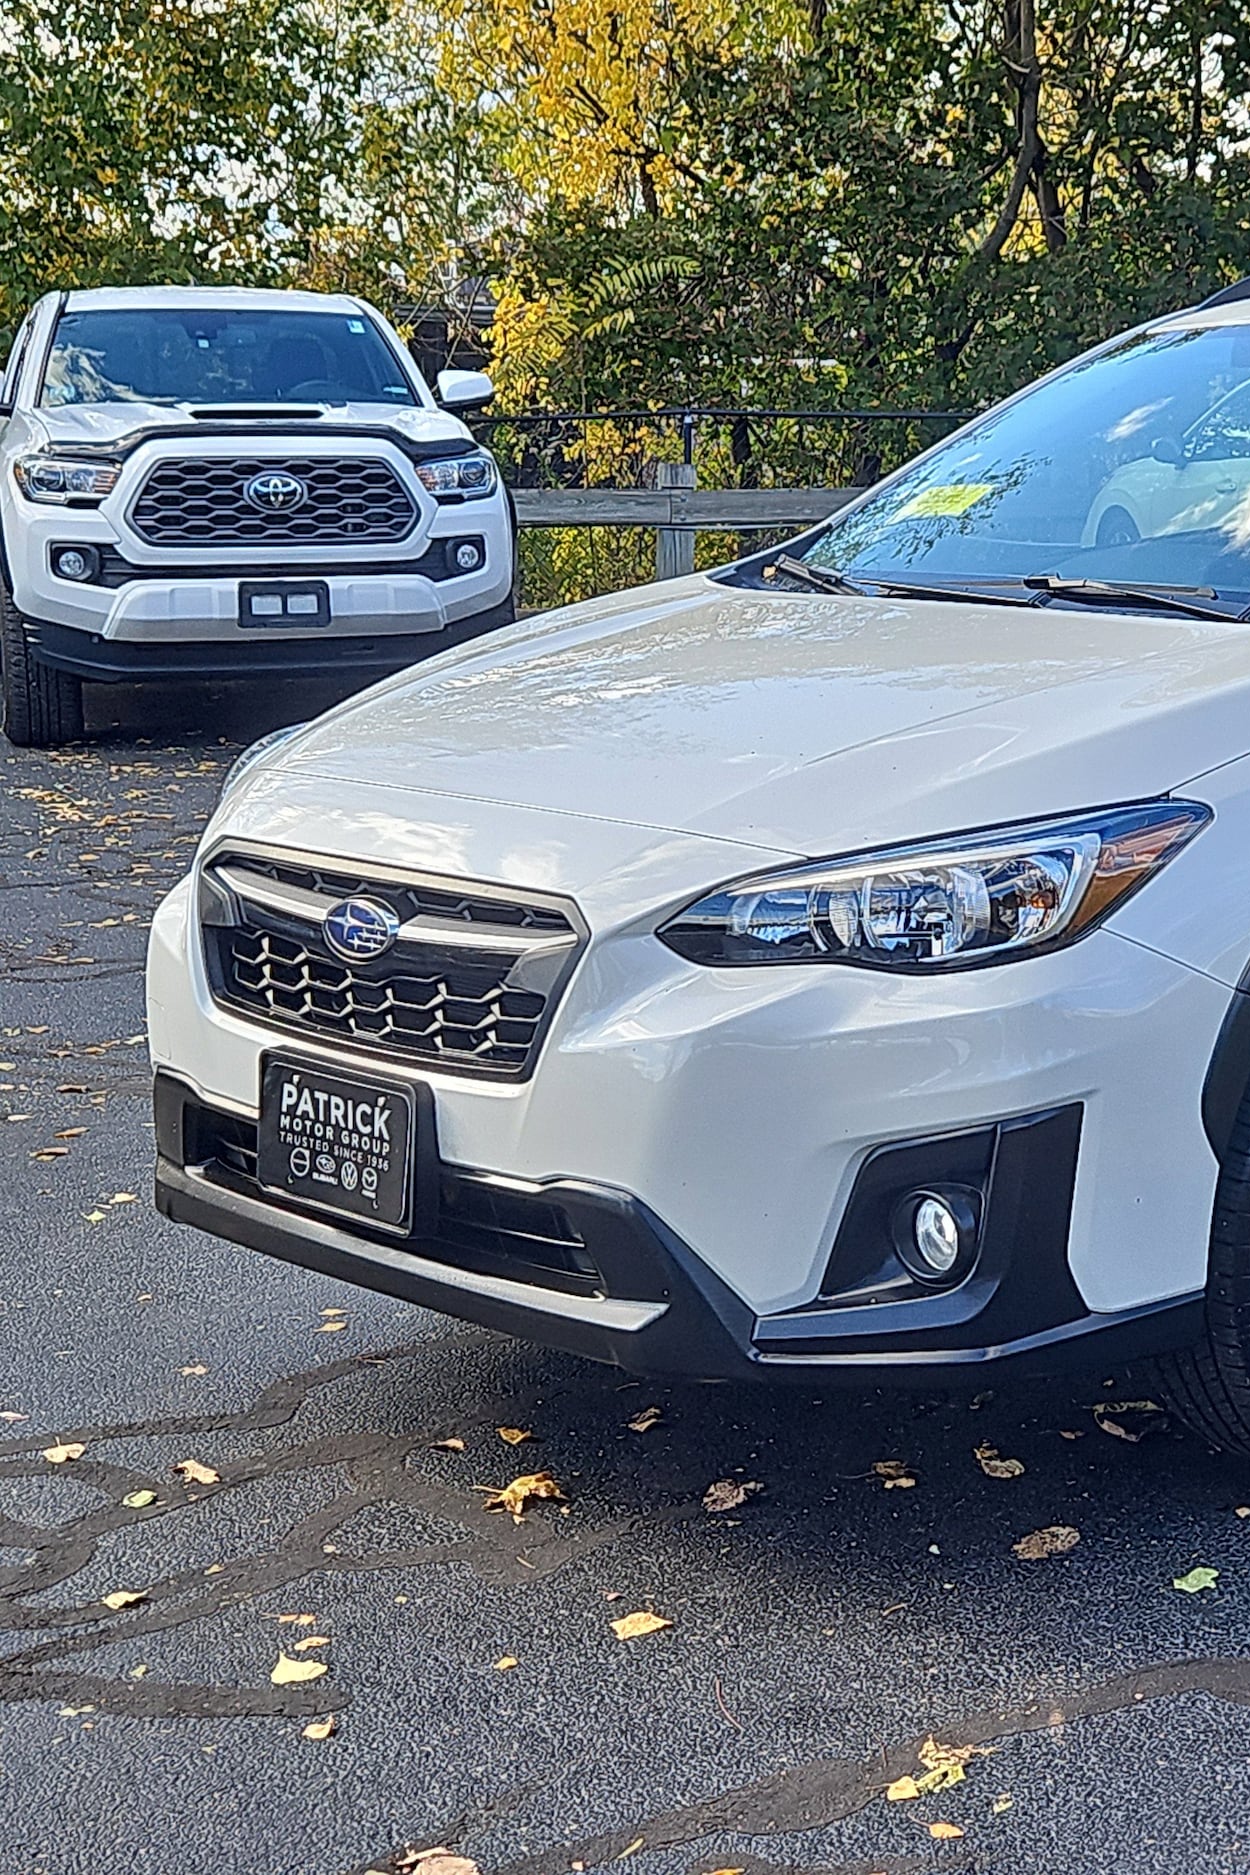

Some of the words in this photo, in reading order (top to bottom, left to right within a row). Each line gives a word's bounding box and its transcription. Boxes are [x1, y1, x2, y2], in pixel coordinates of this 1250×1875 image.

[281, 1082, 392, 1141] PATRICK
[279, 1131, 329, 1152] TRUSTED
[333, 1145, 363, 1163] SINCE
[280, 1114, 334, 1140] MOTOR
[340, 1130, 390, 1156] GROUP
